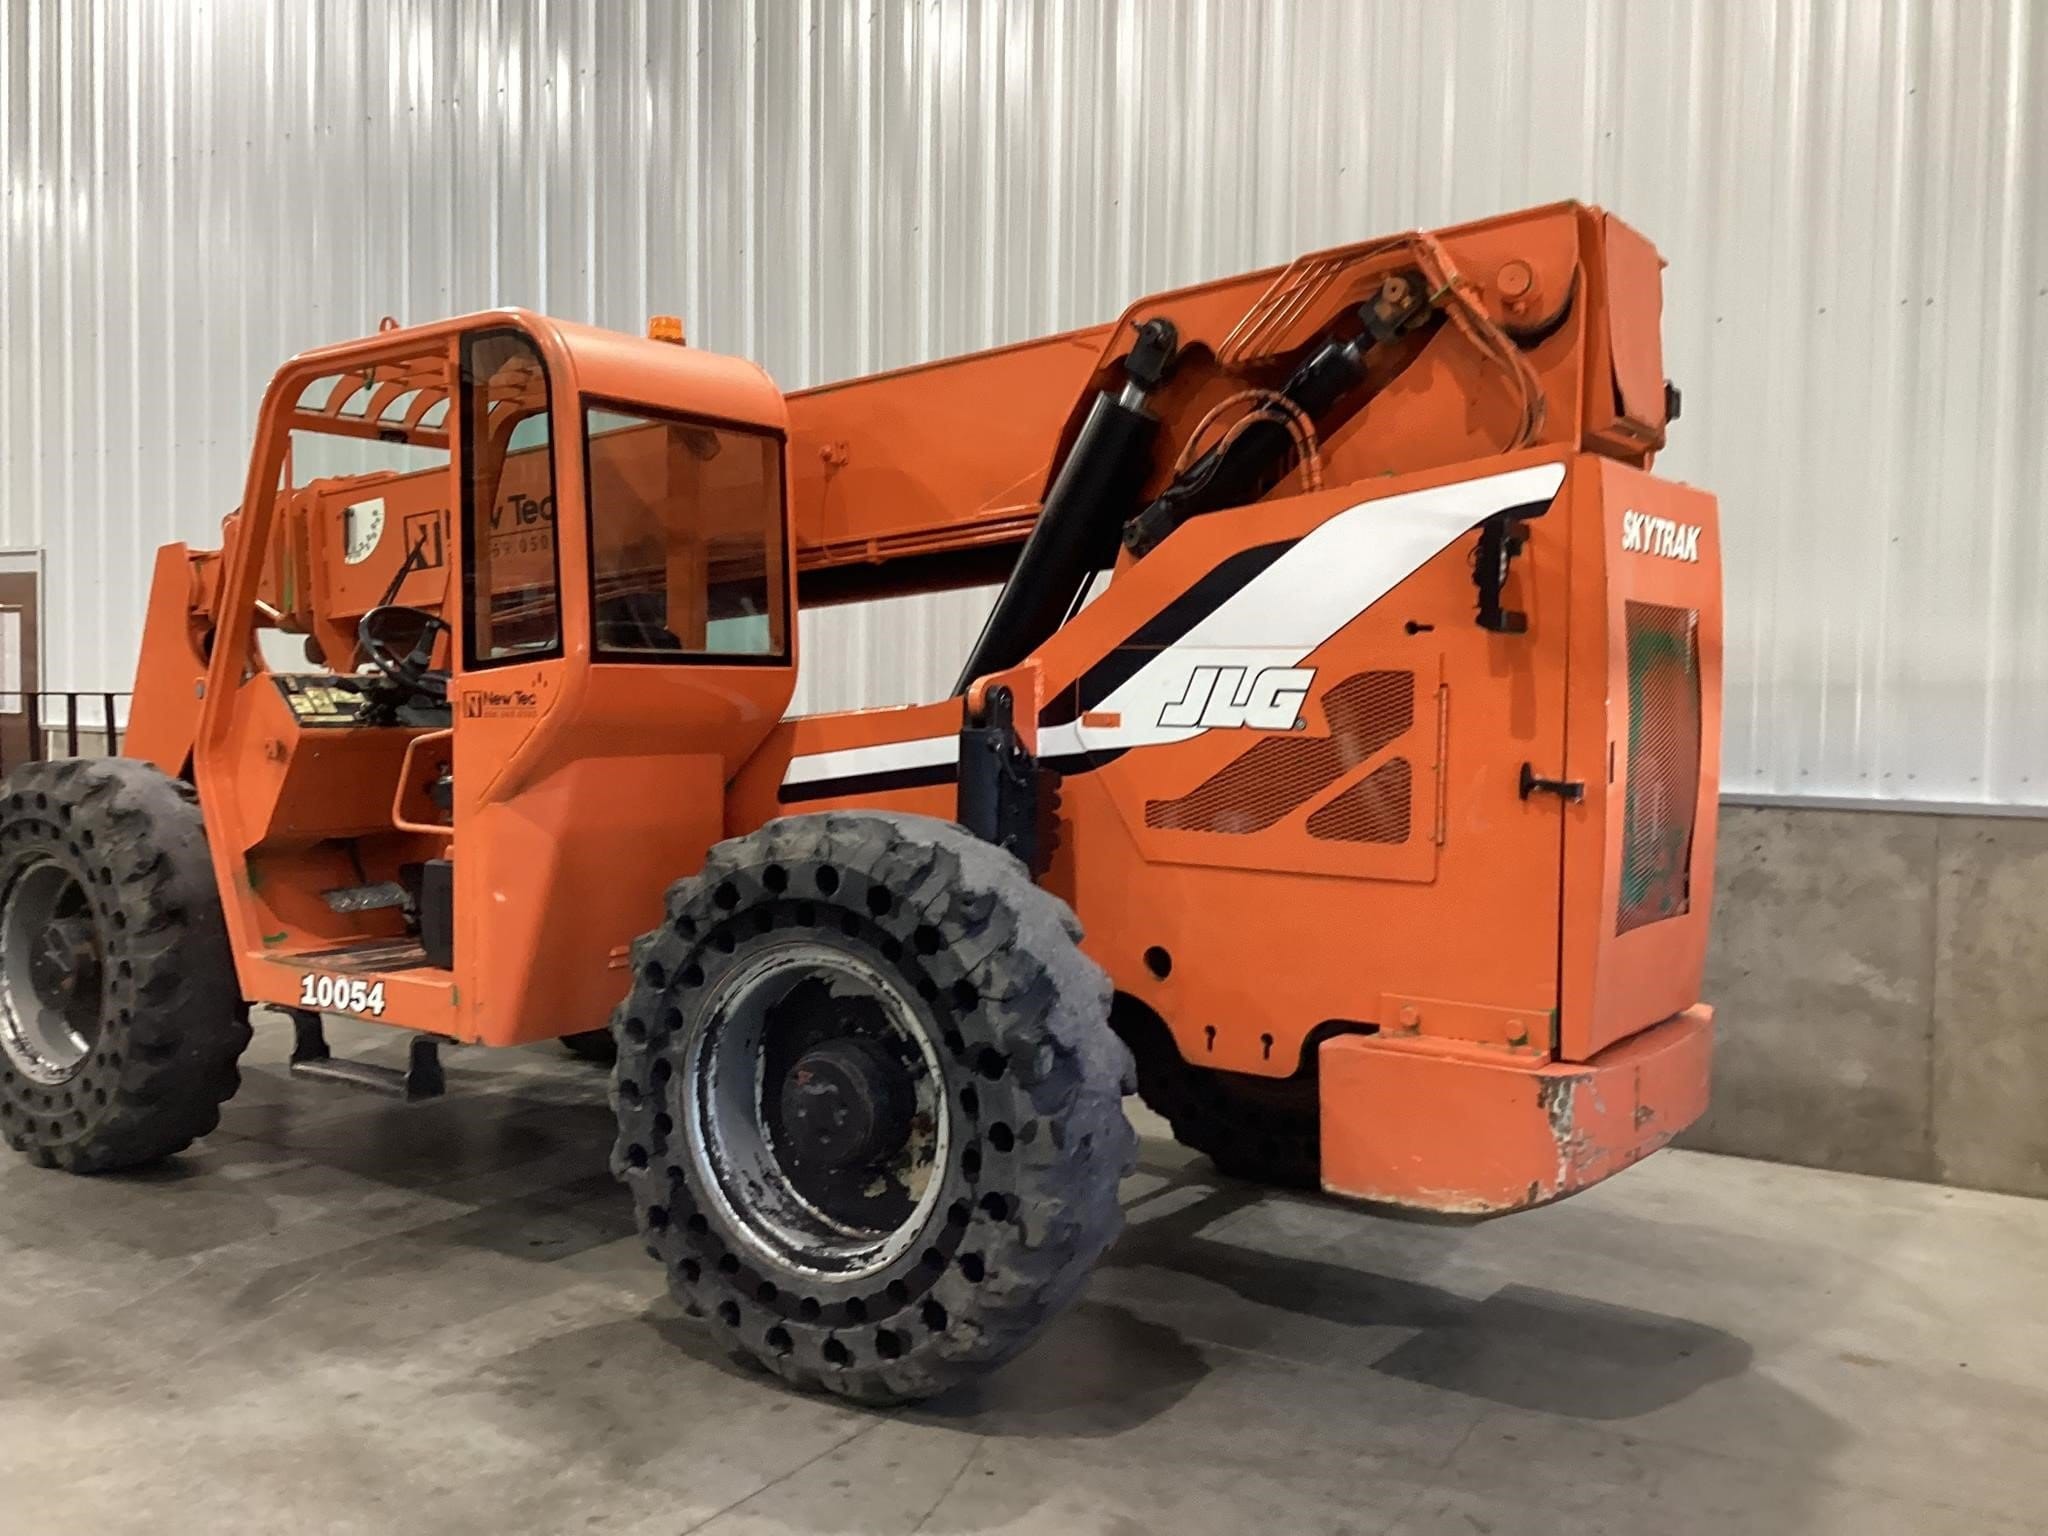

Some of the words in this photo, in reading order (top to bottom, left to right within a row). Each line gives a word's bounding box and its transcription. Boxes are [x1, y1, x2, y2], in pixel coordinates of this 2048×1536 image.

[1622, 509, 1702, 563] SKYTRAK
[483, 691, 512, 705] New
[514, 691, 536, 705] Tec
[1156, 666, 1318, 731] JLG
[301, 973, 385, 1016] 10054
